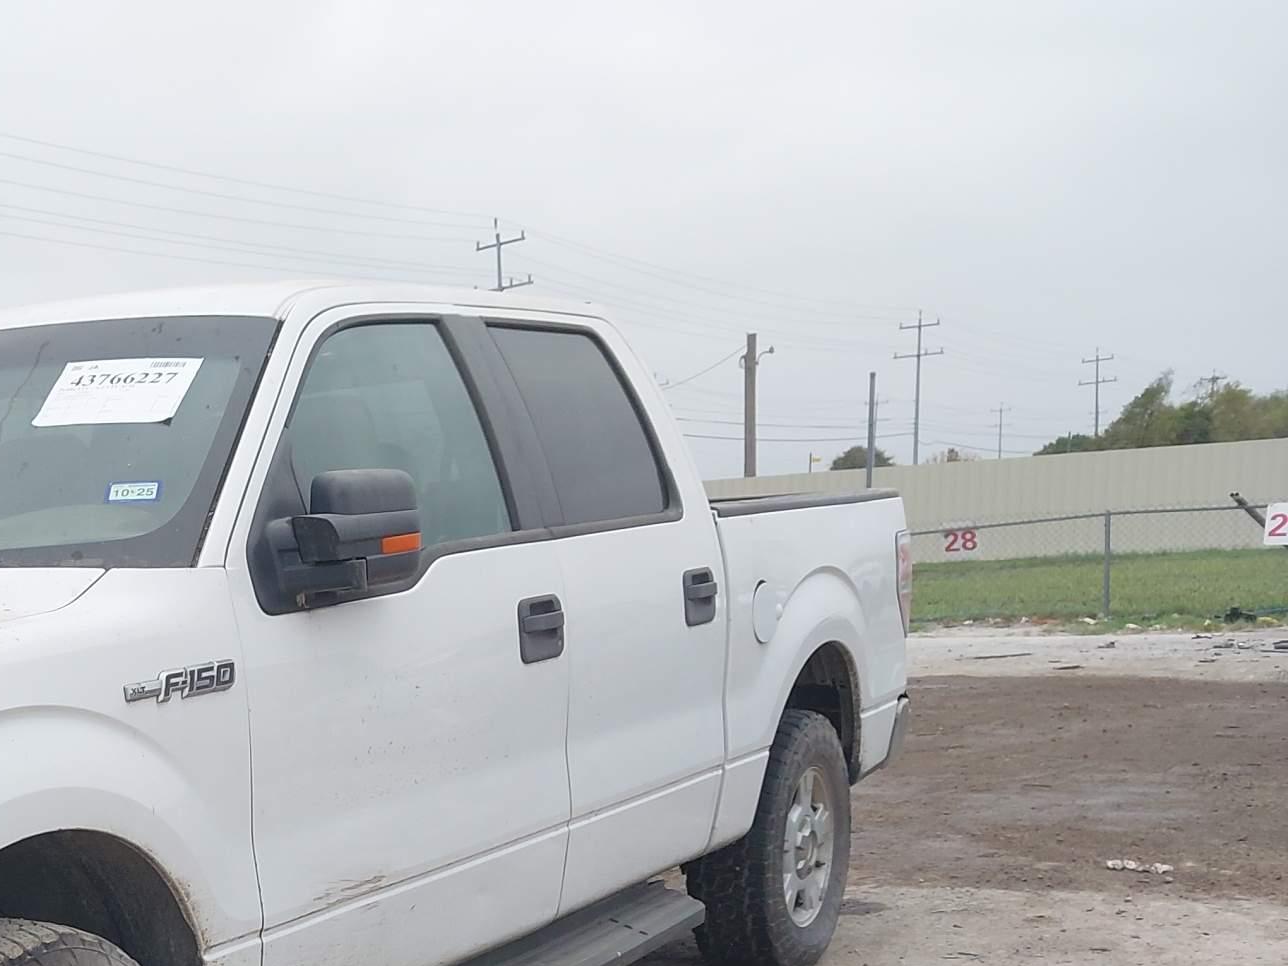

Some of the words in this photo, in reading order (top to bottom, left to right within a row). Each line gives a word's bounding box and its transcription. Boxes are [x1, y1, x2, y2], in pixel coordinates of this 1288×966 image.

[70, 372, 178, 386] 43766227
[944, 529, 977, 551] 28
[130, 685, 146, 696] XLT
[158, 661, 235, 703] F-150
